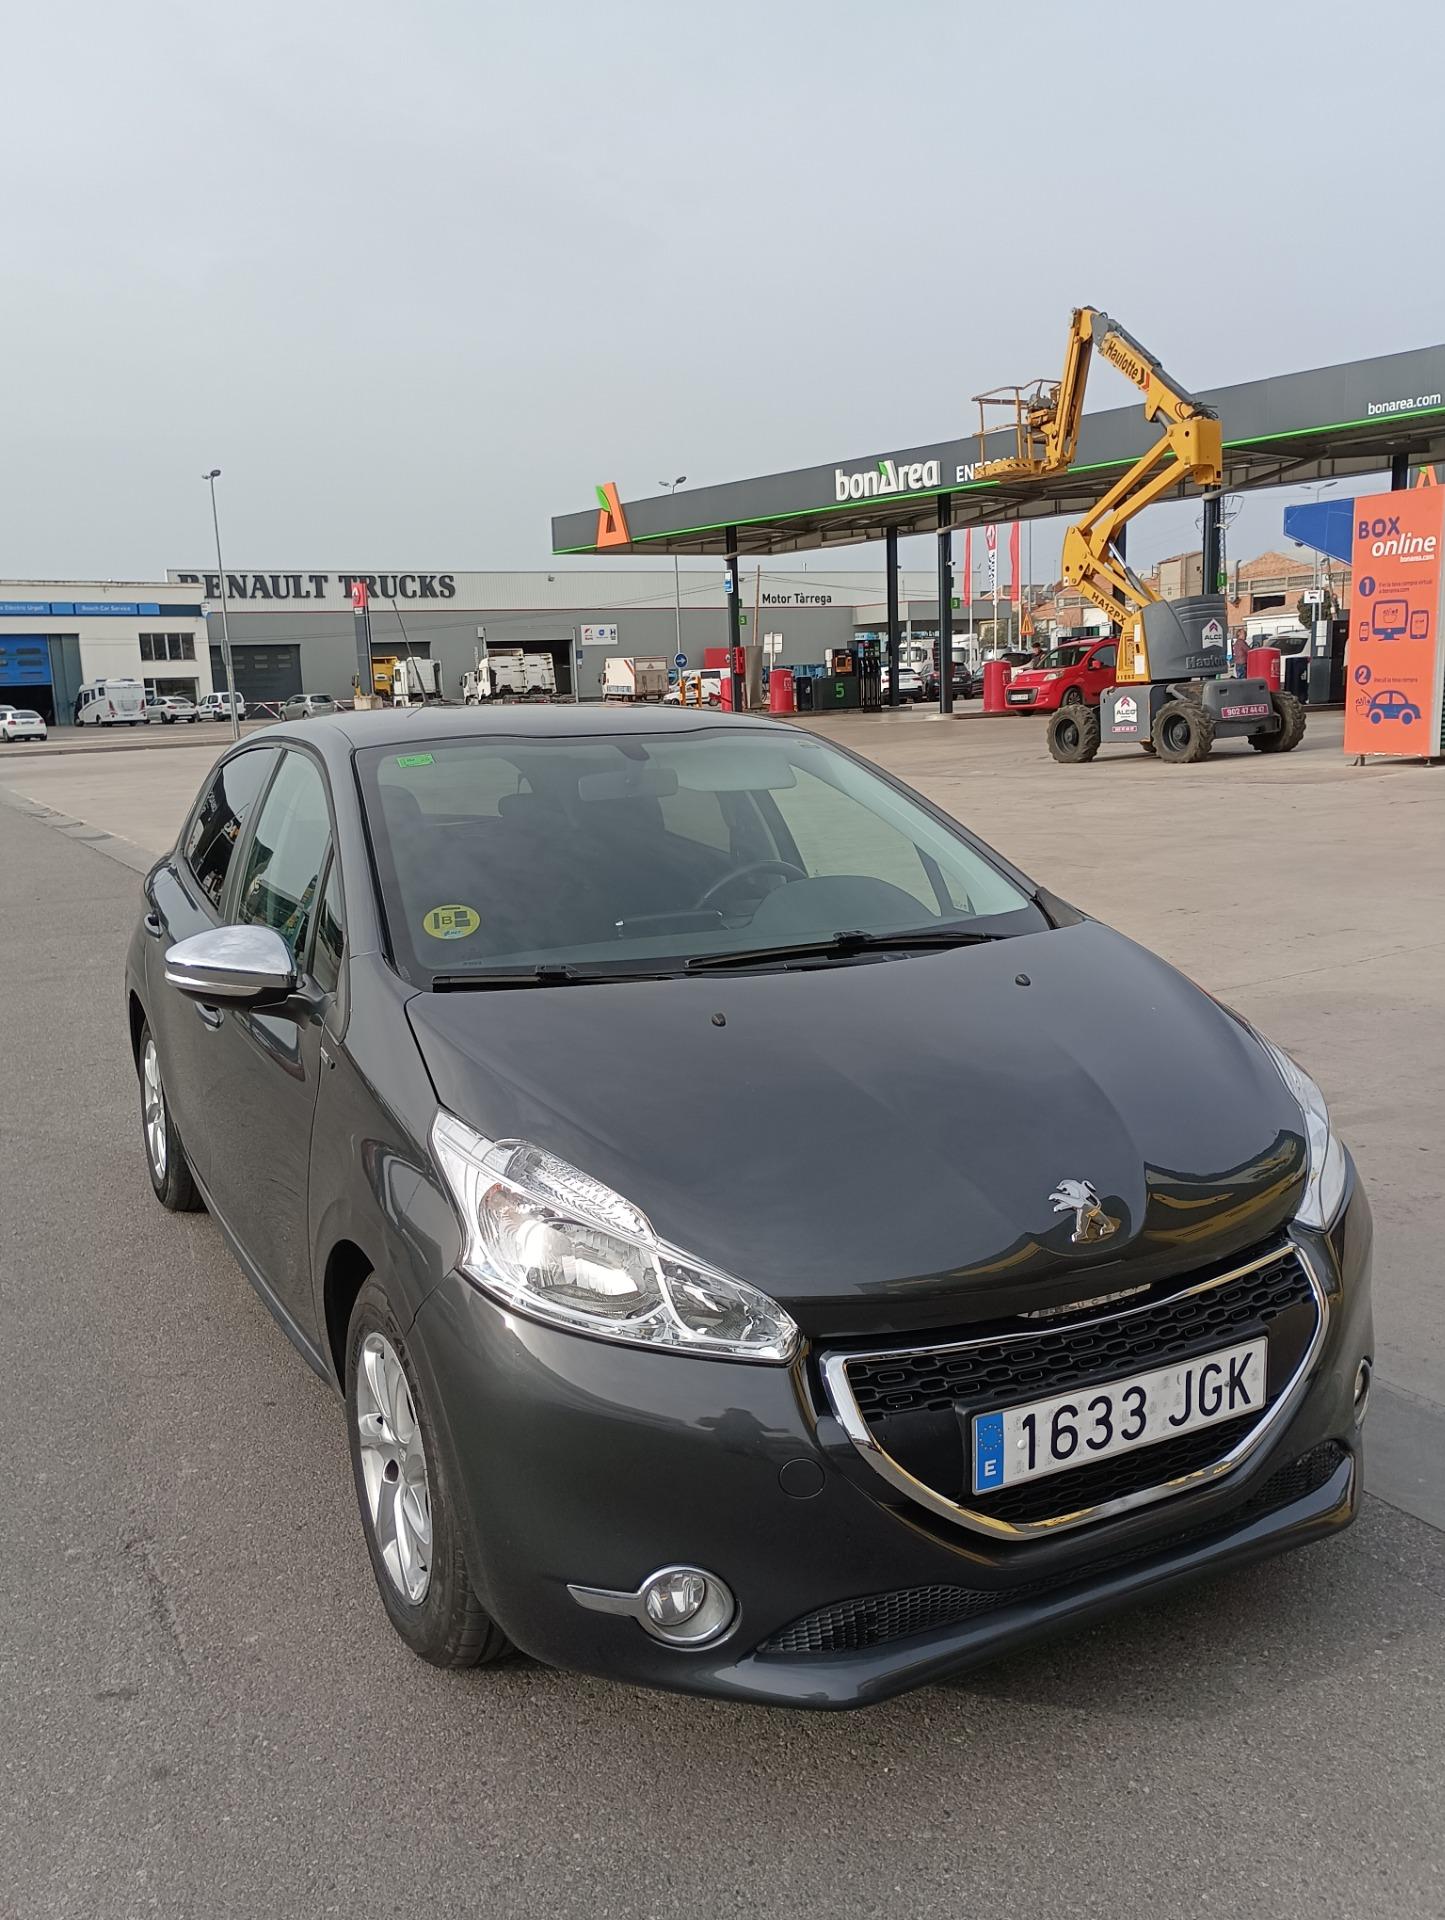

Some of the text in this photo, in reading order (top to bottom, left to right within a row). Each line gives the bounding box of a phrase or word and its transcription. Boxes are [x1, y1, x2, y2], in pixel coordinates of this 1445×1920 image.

[1105, 340, 1139, 380] Haulotte
[1368, 394, 1441, 415] bonarea.com
[835, 460, 941, 500] bonArea
[1359, 516, 1400, 539] BOX
[1371, 532, 1436, 557] online
[338, 574, 456, 599] TRUCKS
[1363, 579, 1371, 595] 1
[762, 592, 832, 606] Motor Tàrrega
[1091, 592, 1126, 625] HA12PX
[1358, 668, 1367, 684] 2
[835, 682, 845, 698] 5
[1226, 708, 1240, 716] 902
[441, 916, 453, 925] B
[1022, 1352, 1253, 1470] 1633 JGK
[984, 1460, 997, 1477] E
